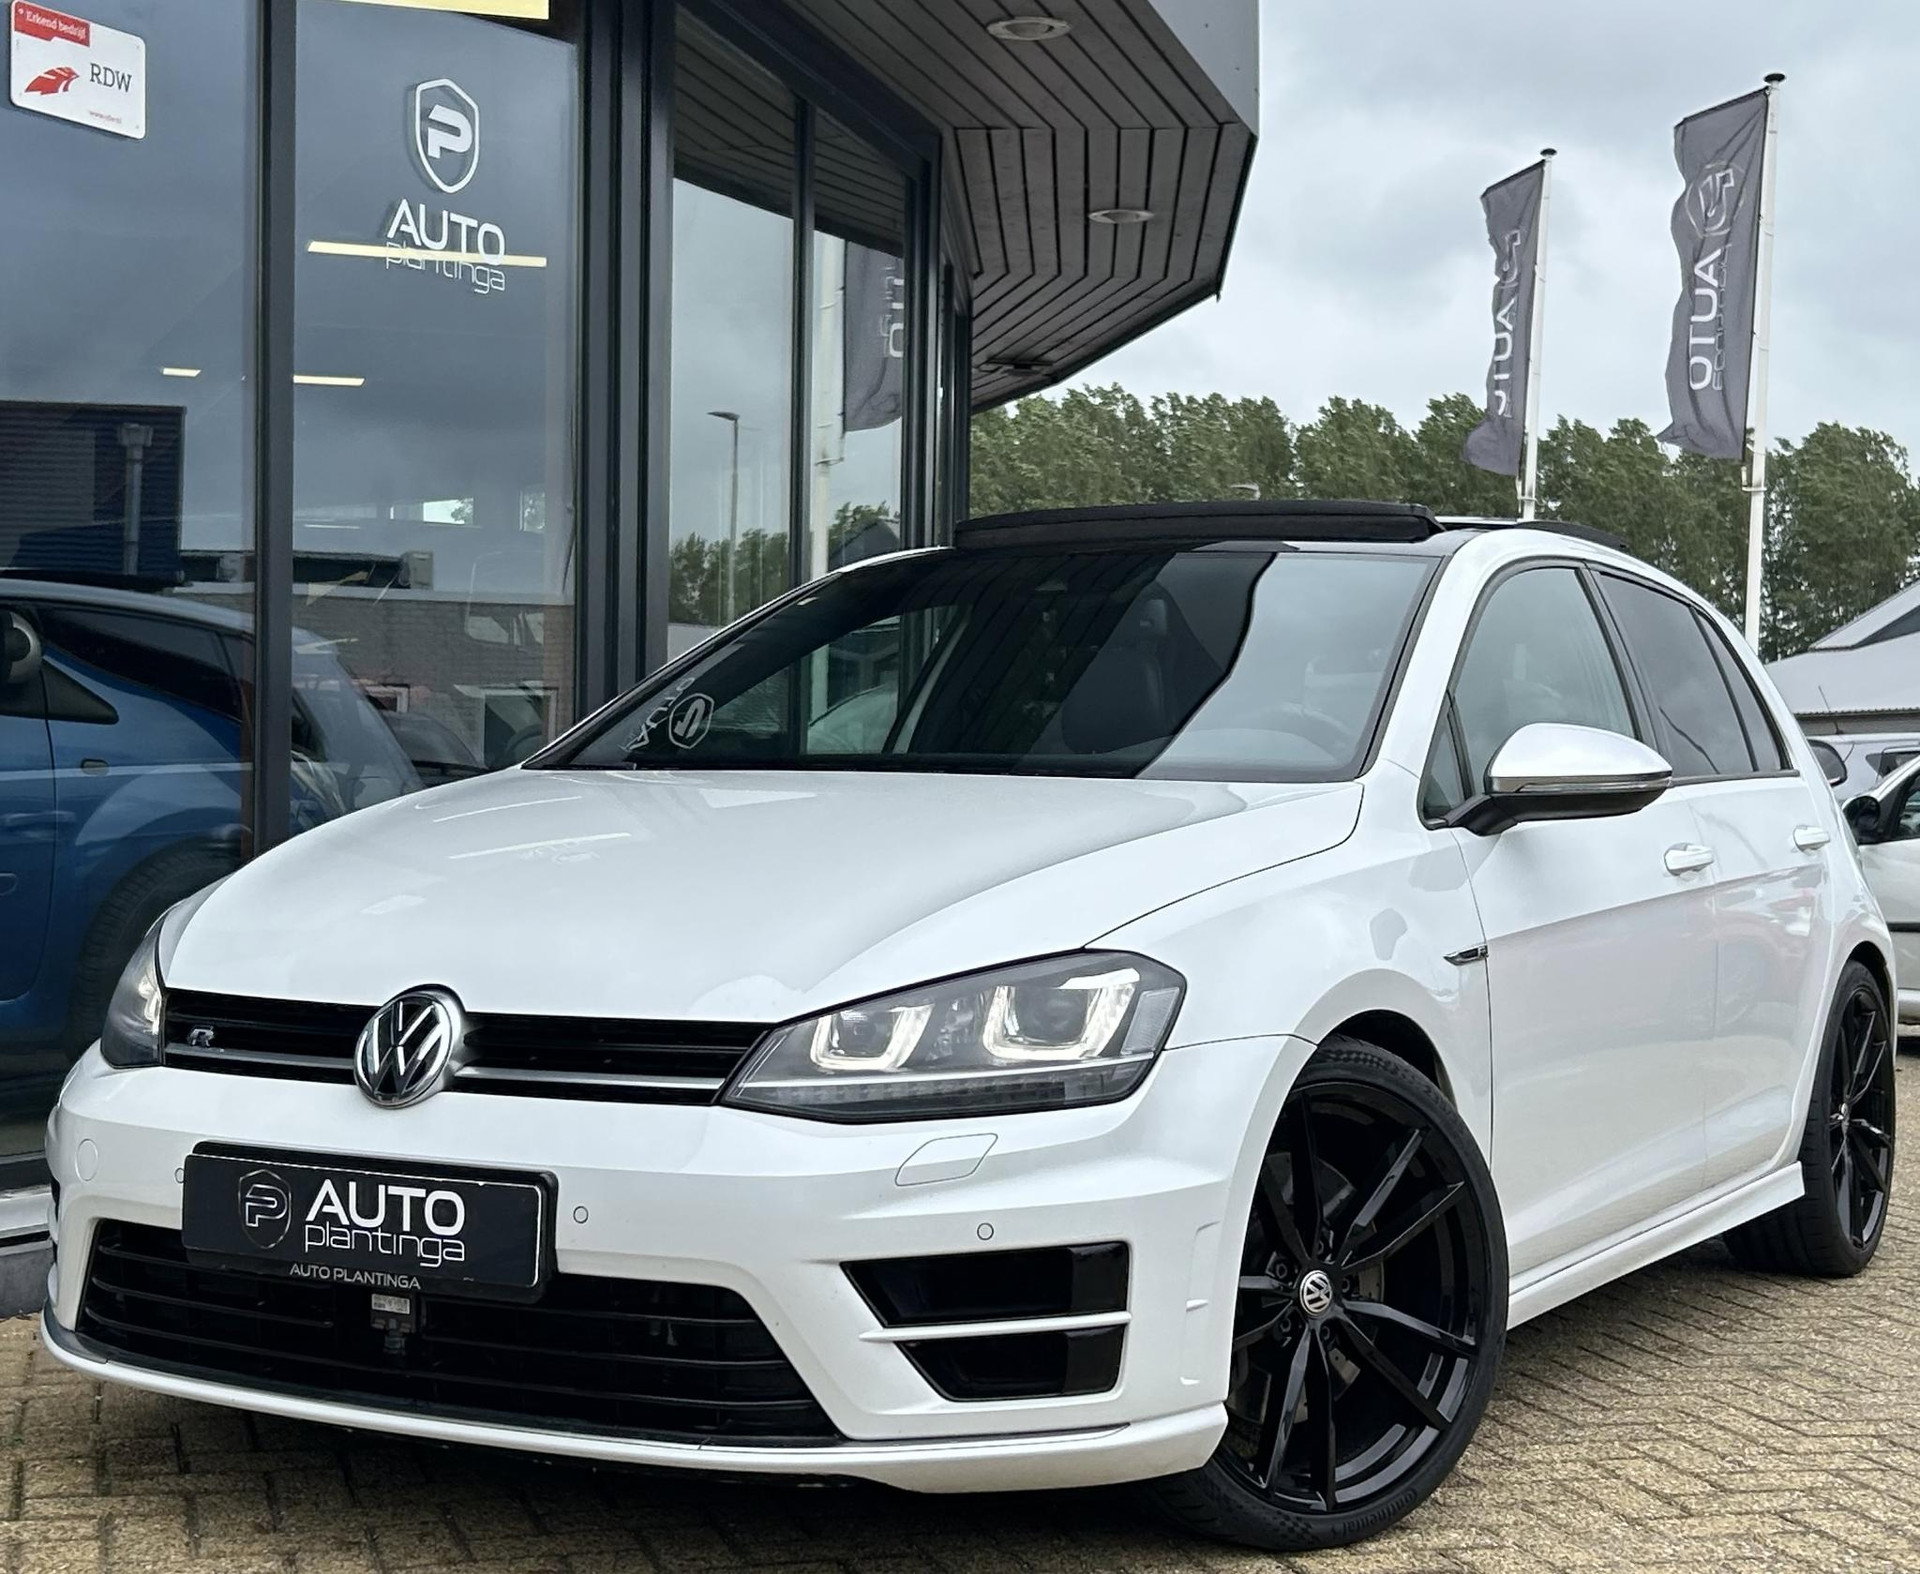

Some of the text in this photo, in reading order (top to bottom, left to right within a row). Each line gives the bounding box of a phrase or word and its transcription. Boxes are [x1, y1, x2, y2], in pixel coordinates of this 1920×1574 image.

[90, 62, 132, 93] RDW
[387, 198, 505, 266] AUTO
[385, 240, 506, 295] plantinga
[305, 1178, 465, 1236] AUTO
[304, 1221, 465, 1268] plantinga
[290, 1263, 421, 1290] AUTO PLANTINGA
